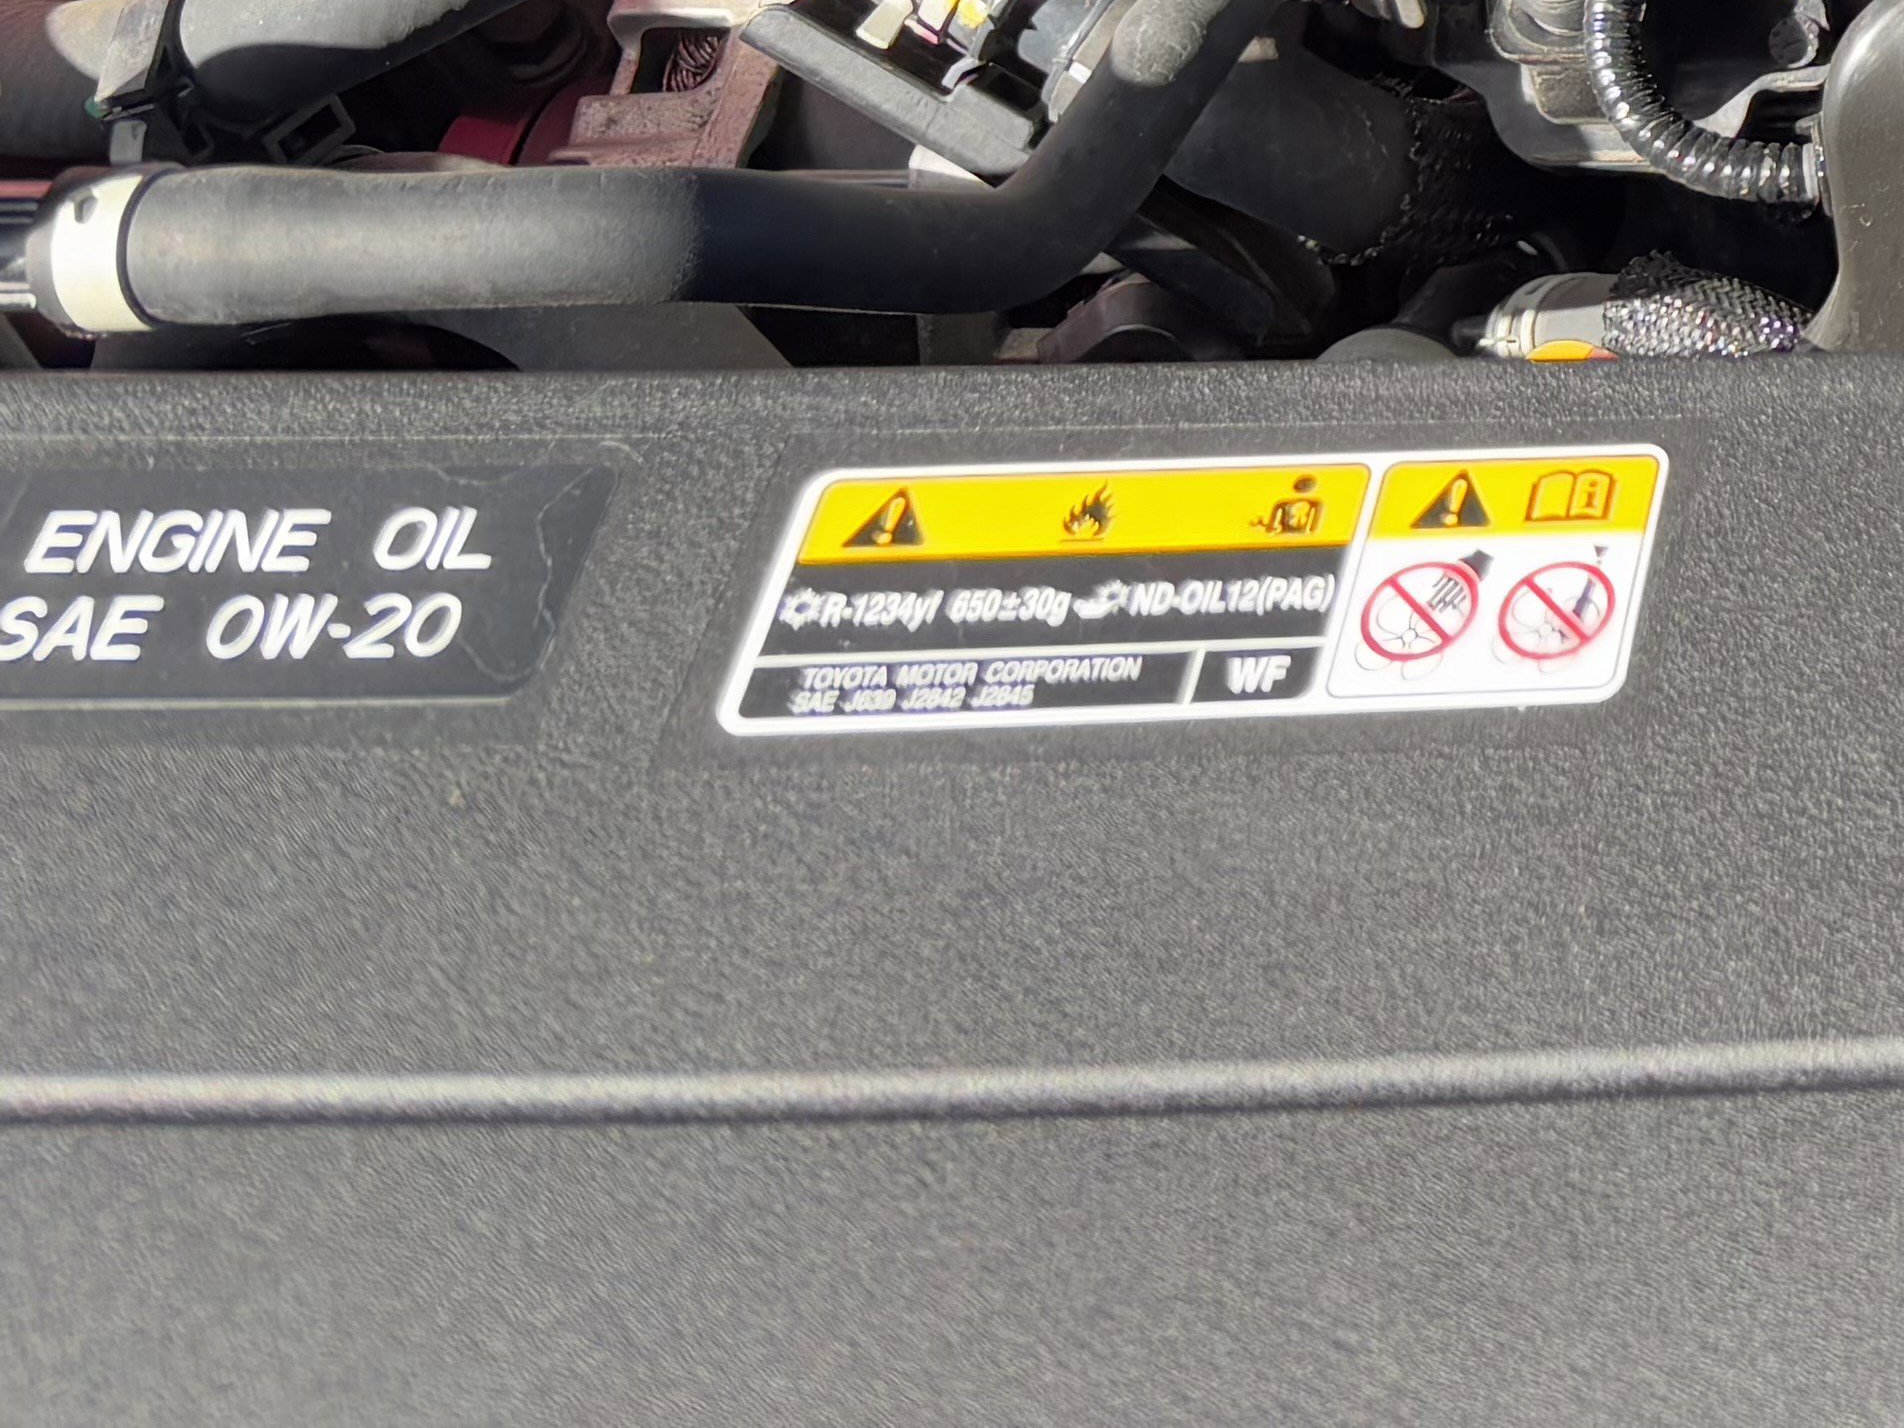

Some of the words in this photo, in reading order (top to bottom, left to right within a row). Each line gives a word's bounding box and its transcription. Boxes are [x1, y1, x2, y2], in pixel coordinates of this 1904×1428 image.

[23, 507, 333, 574] ENGINE
[372, 506, 493, 571] OIL
[0, 594, 165, 662] SAE
[206, 591, 464, 660] 0W-20
[947, 586, 1072, 627] 650±30g
[802, 664, 888, 690] TOYOTA
[895, 661, 979, 688] MOTOR
[984, 655, 1143, 684] CORPORATION
[1227, 654, 1292, 694] WF
[790, 690, 840, 715] SAE
